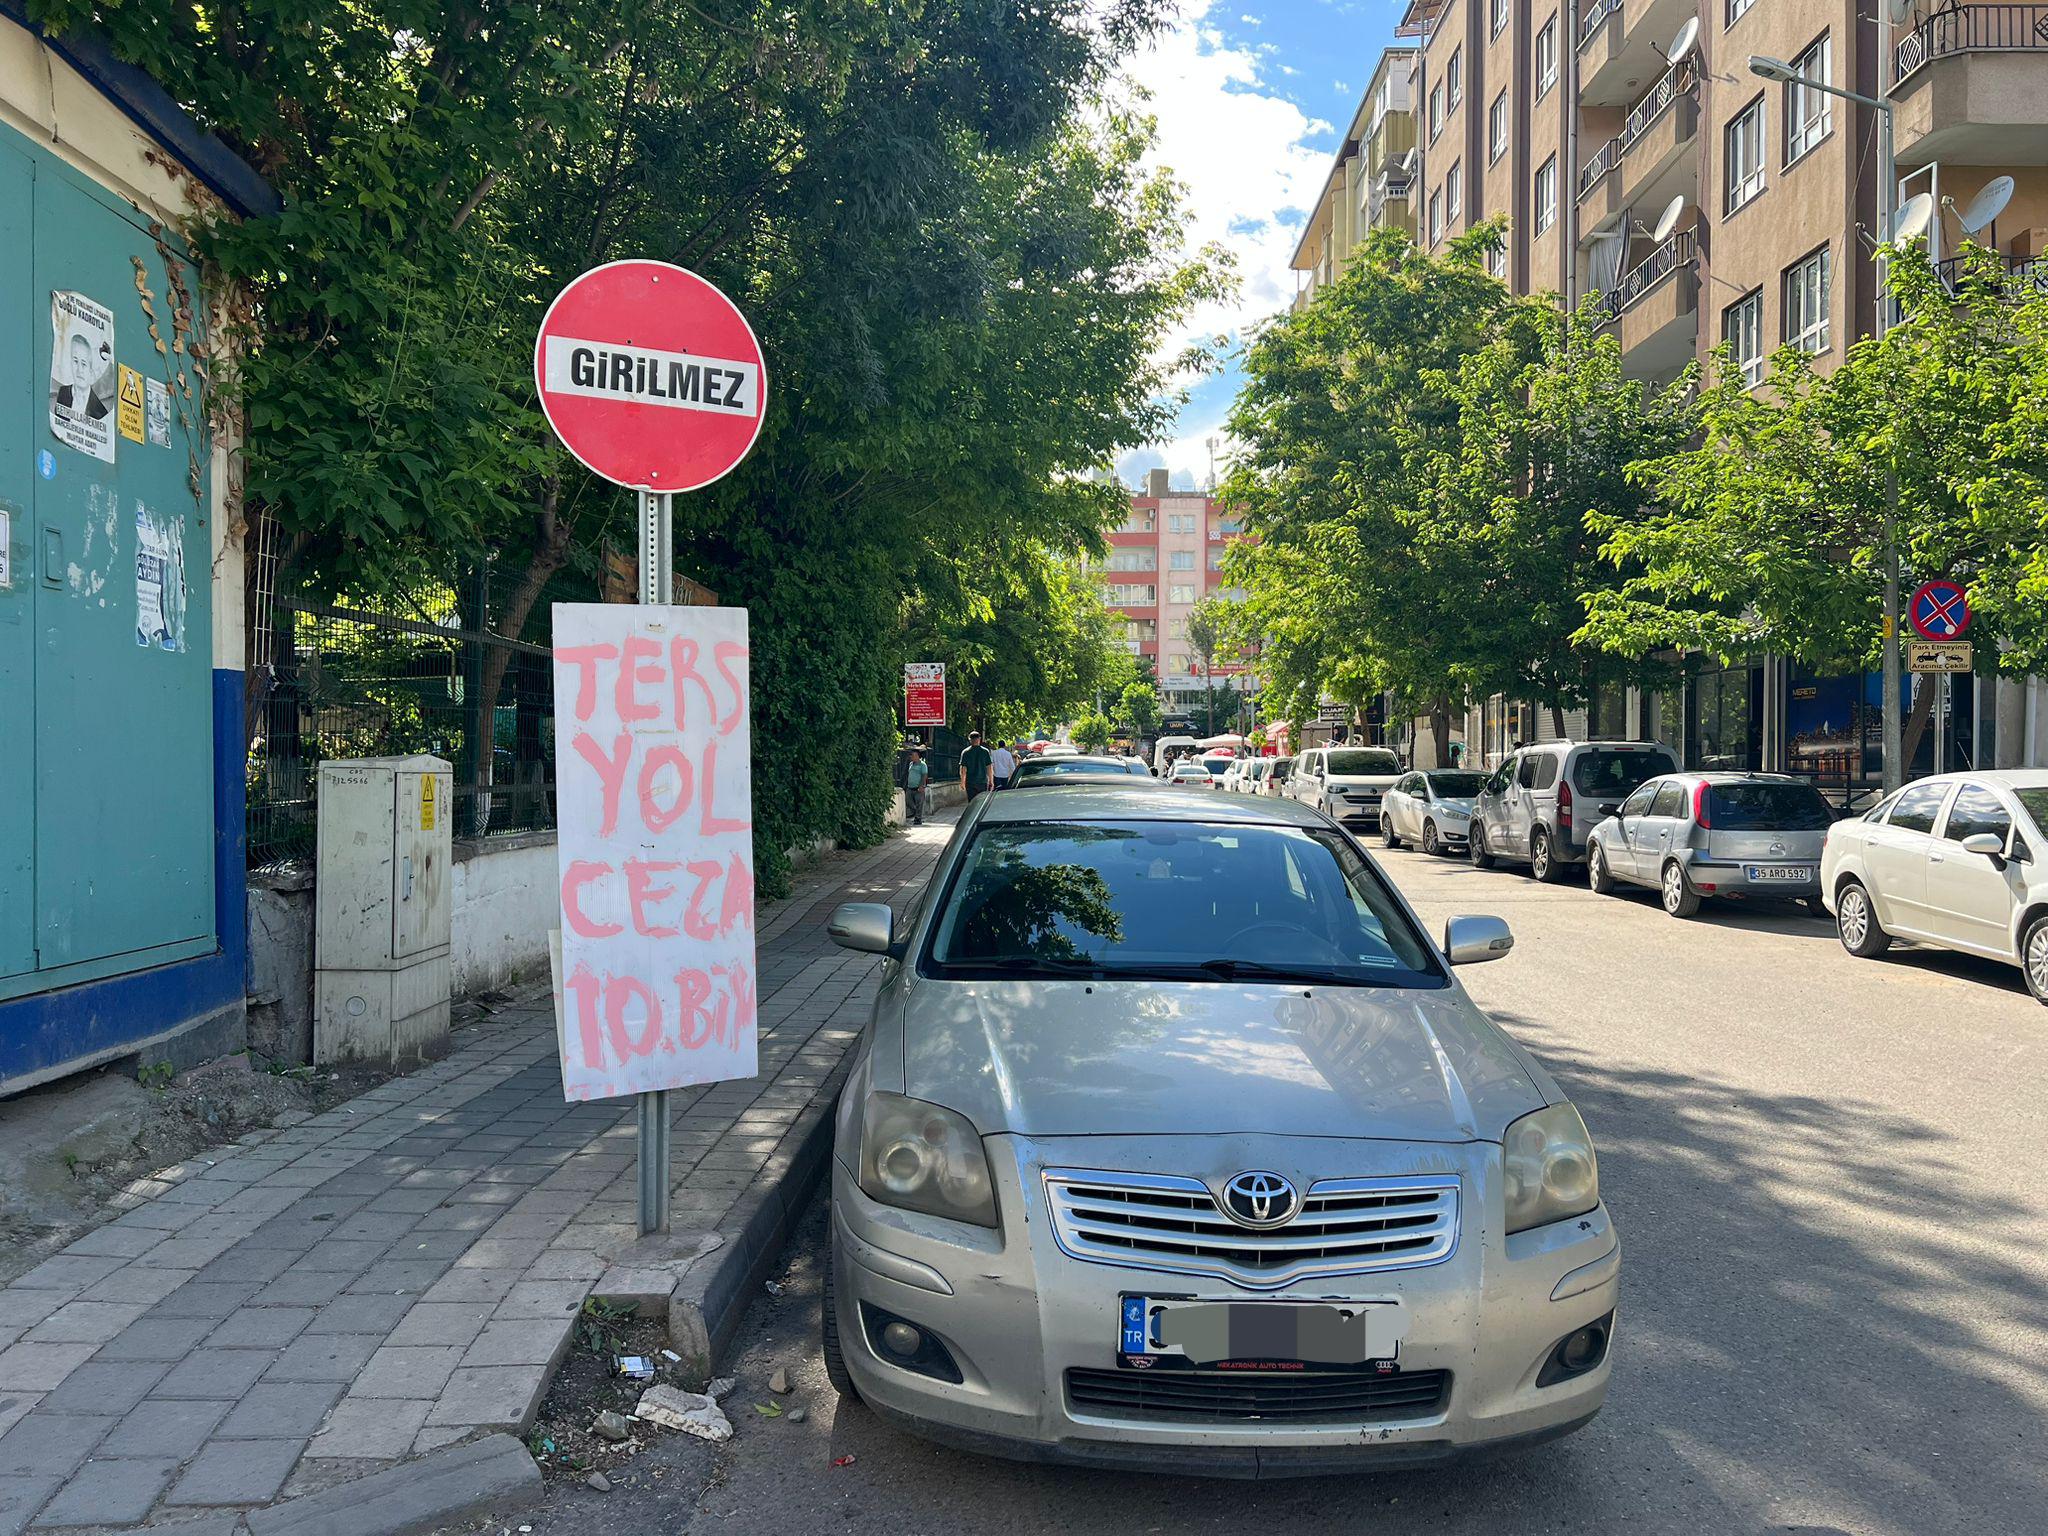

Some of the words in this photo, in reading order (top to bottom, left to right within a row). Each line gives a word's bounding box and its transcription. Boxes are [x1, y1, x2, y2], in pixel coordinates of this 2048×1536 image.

[138, 568, 161, 582] AYDIN
[1931, 644, 1968, 652] Etmeyiniz
[553, 634, 749, 736] TERS
[572, 733, 752, 838] YOL
[1755, 869, 1767, 878] 35
[1787, 869, 1805, 879] 592
[562, 850, 754, 941] CEZA
[1125, 1330, 1142, 1343] TR
